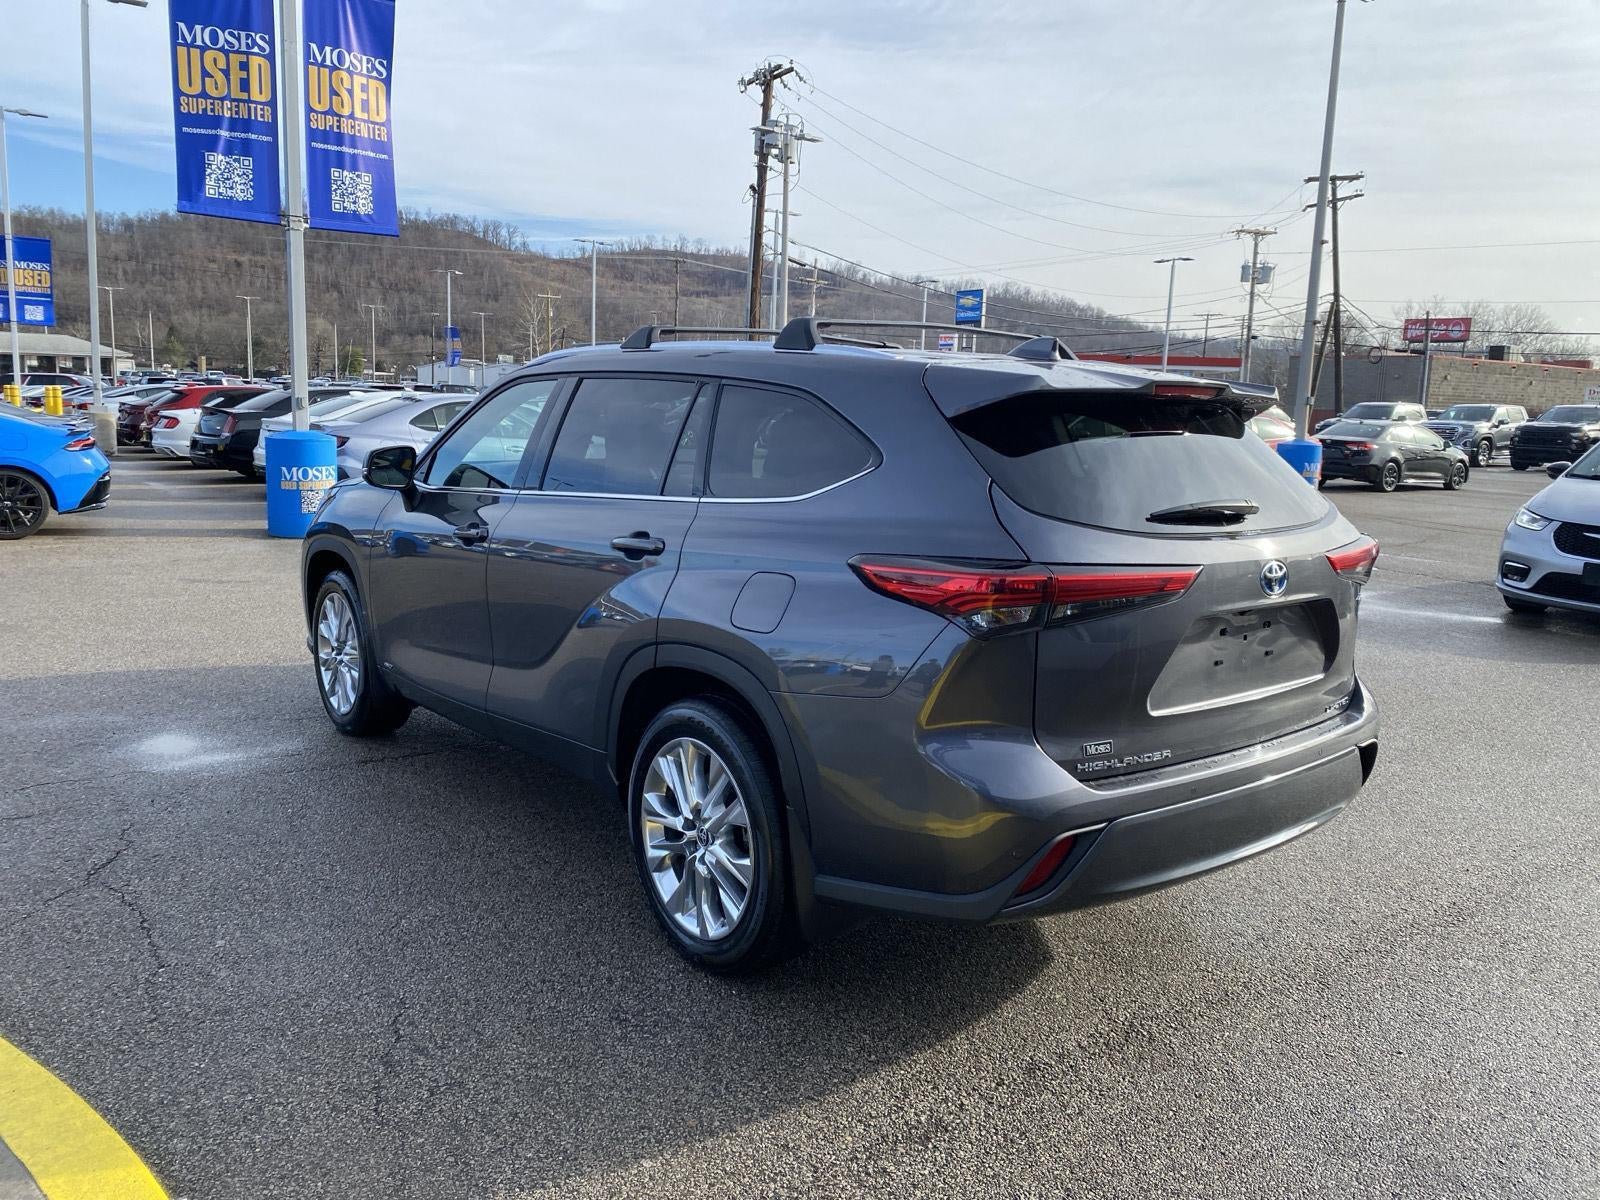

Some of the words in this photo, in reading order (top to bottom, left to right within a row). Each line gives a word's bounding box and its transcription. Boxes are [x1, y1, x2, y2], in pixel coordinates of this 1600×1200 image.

[176, 22, 270, 54] MOSES
[308, 42, 387, 79] MOSES
[177, 46, 271, 103] USED
[308, 65, 387, 123] USED
[180, 96, 272, 123] SUPERCENTER
[182, 126, 273, 142] mosesusedsupercenter.com
[310, 112, 388, 142] SUPERCENTER
[311, 141, 389, 160] mosesusedsupercenter.com
[14, 261, 50, 271] MOSES
[15, 269, 50, 287] USED
[281, 466, 335, 481] MOSES
[1077, 749, 1172, 772] HIGHLANDER
[1086, 743, 1111, 755] MOSES
